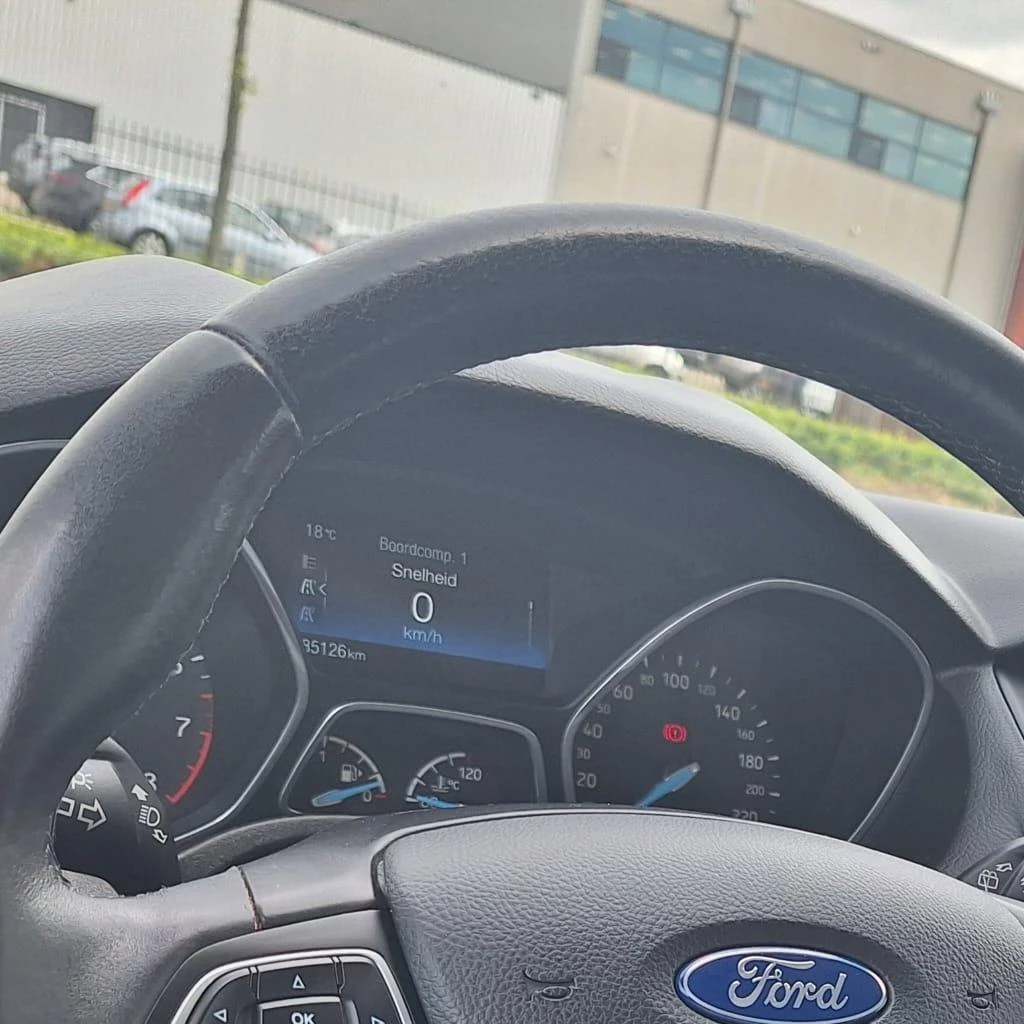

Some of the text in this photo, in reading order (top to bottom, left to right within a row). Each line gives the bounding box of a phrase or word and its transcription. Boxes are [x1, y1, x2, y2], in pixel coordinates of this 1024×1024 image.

[391, 562, 458, 588] Snelheid
[412, 591, 435, 623] 0
[403, 626, 443, 645] km/h
[663, 672, 690, 690] 100
[613, 685, 634, 701] 60
[715, 704, 741, 722] 140
[175, 716, 191, 737] 7
[583, 723, 603, 739] 40
[736, 729, 755, 741] 160
[738, 753, 764, 770] 180
[458, 767, 483, 782] 120
[576, 772, 597, 788] 20
[745, 784, 765, 796] 200
[728, 955, 849, 1010] Ford
